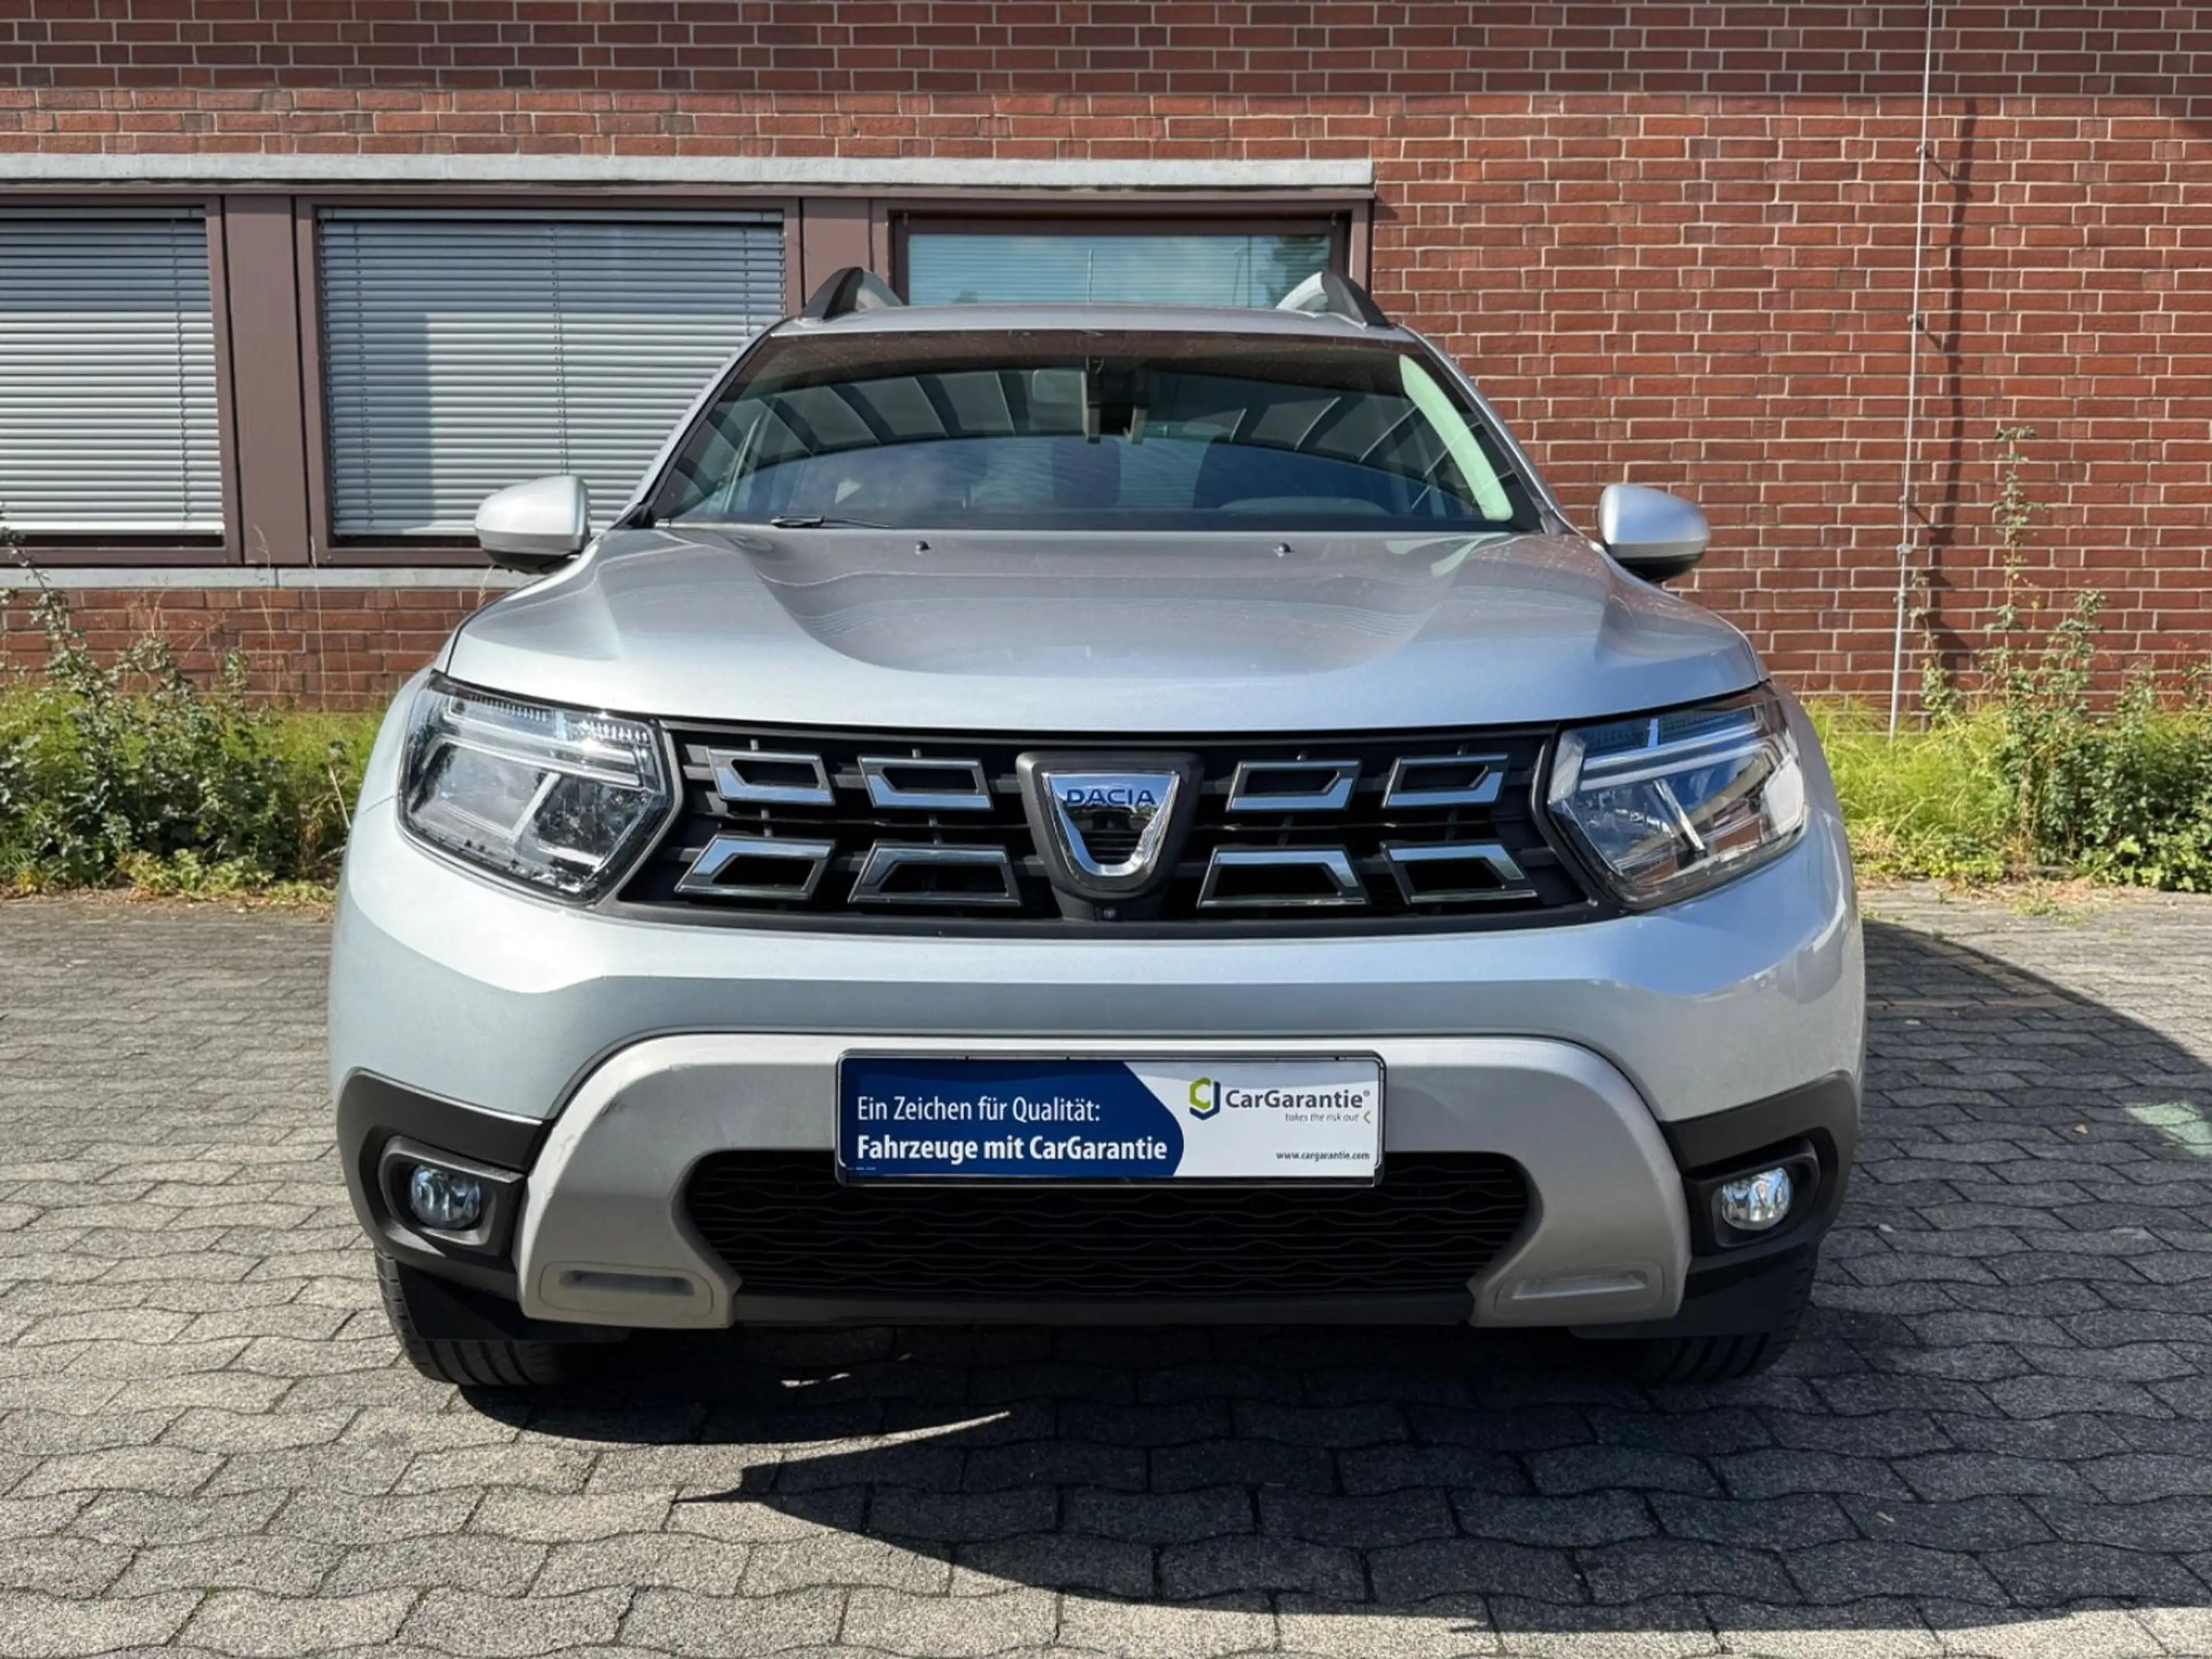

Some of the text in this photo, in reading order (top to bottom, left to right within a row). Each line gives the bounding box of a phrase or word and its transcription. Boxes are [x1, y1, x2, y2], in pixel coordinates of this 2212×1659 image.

[1067, 789, 1156, 805] DACIA
[857, 1095, 1101, 1123] Ein Zeichen für Qualität:
[1285, 1113, 1359, 1122] takes the risk out
[857, 1134, 1168, 1165] Fahrzeuge mit CarGarantie
[1276, 1151, 1370, 1162] www.cargarantie.com
